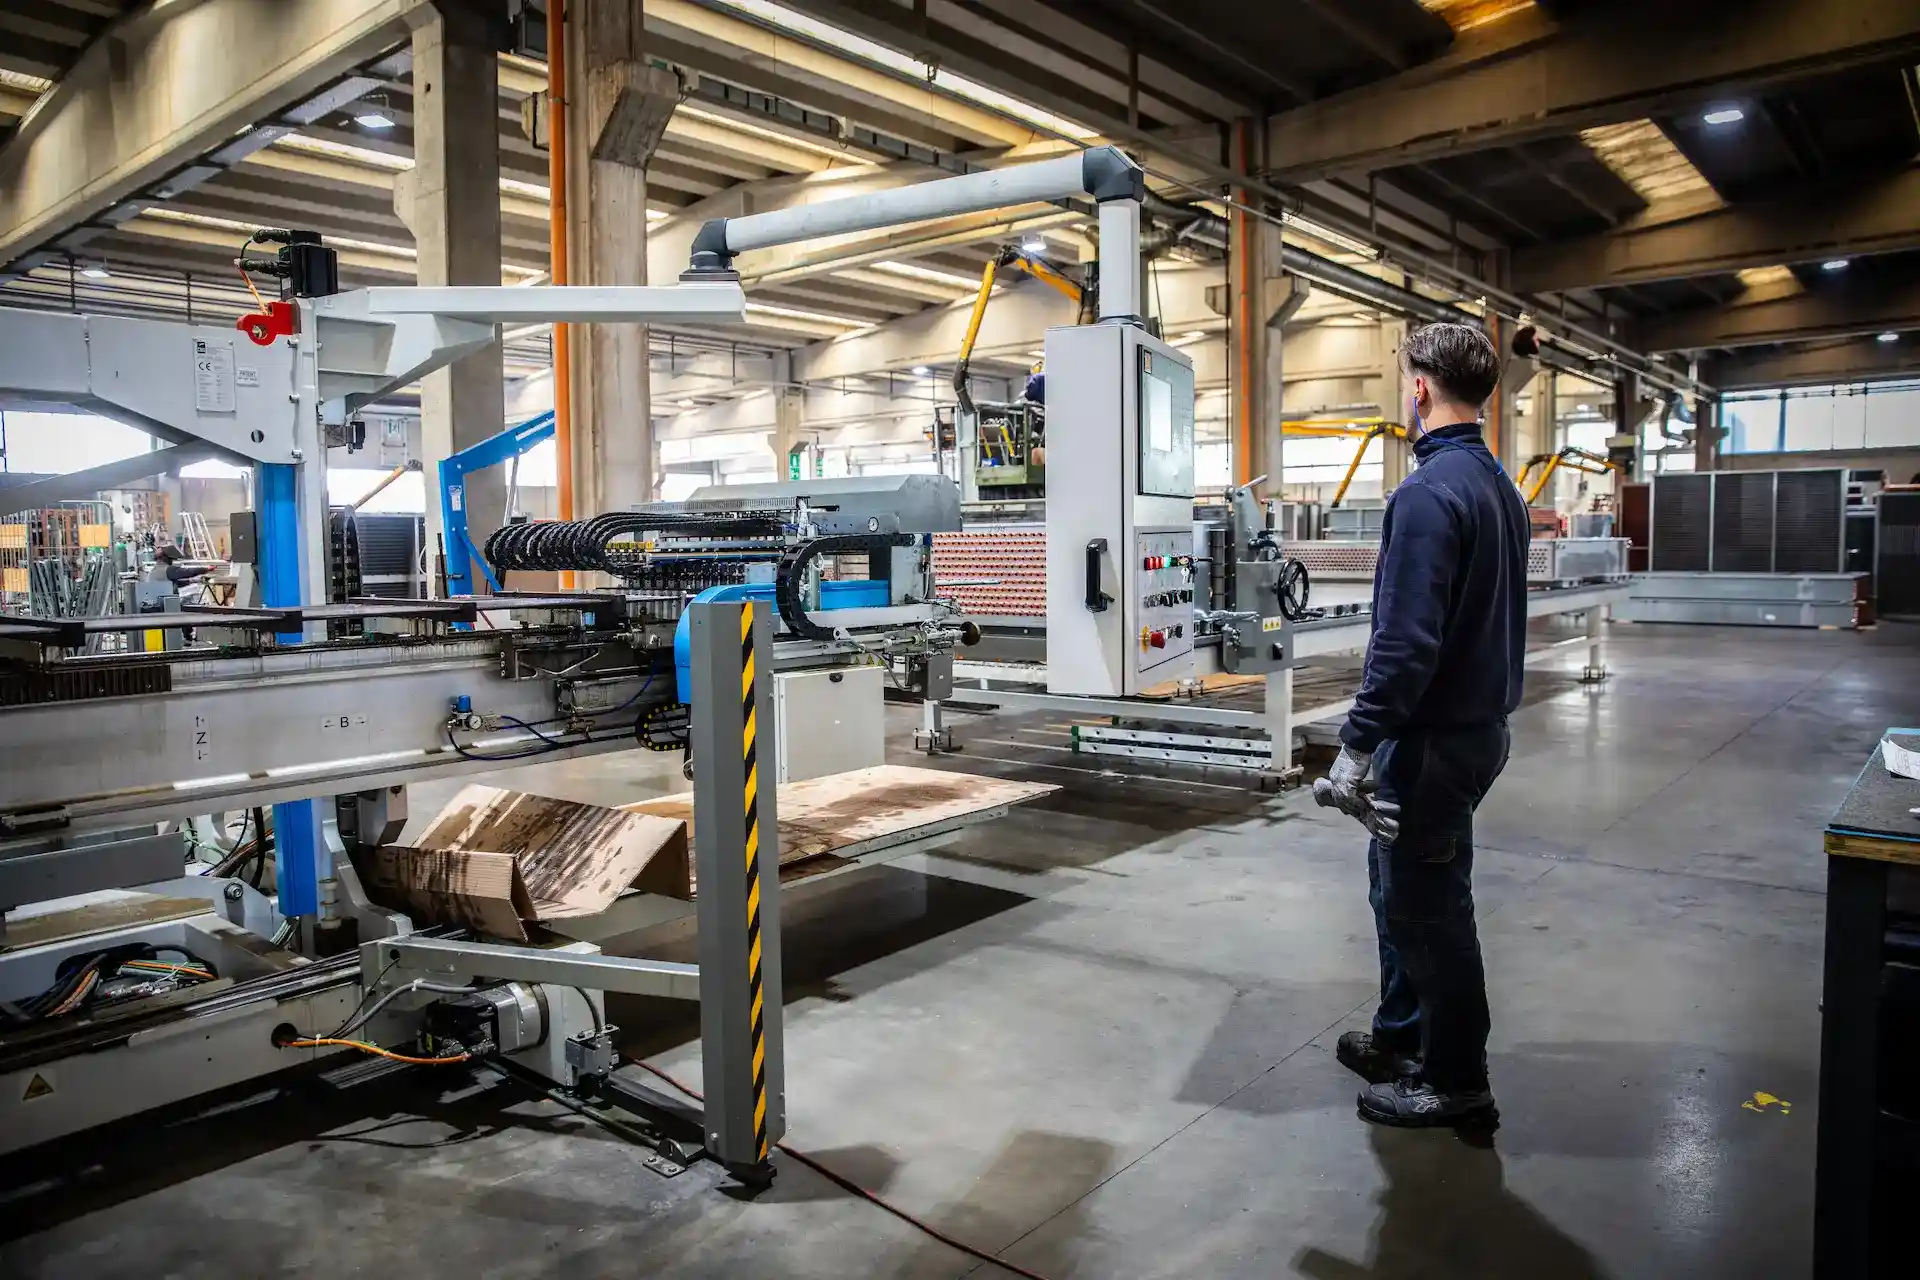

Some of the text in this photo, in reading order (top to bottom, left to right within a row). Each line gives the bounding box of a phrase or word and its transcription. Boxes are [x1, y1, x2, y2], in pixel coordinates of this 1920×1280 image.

[198, 361, 211, 372] CE
[340, 716, 349, 728] B
[196, 731, 207, 744] Z
